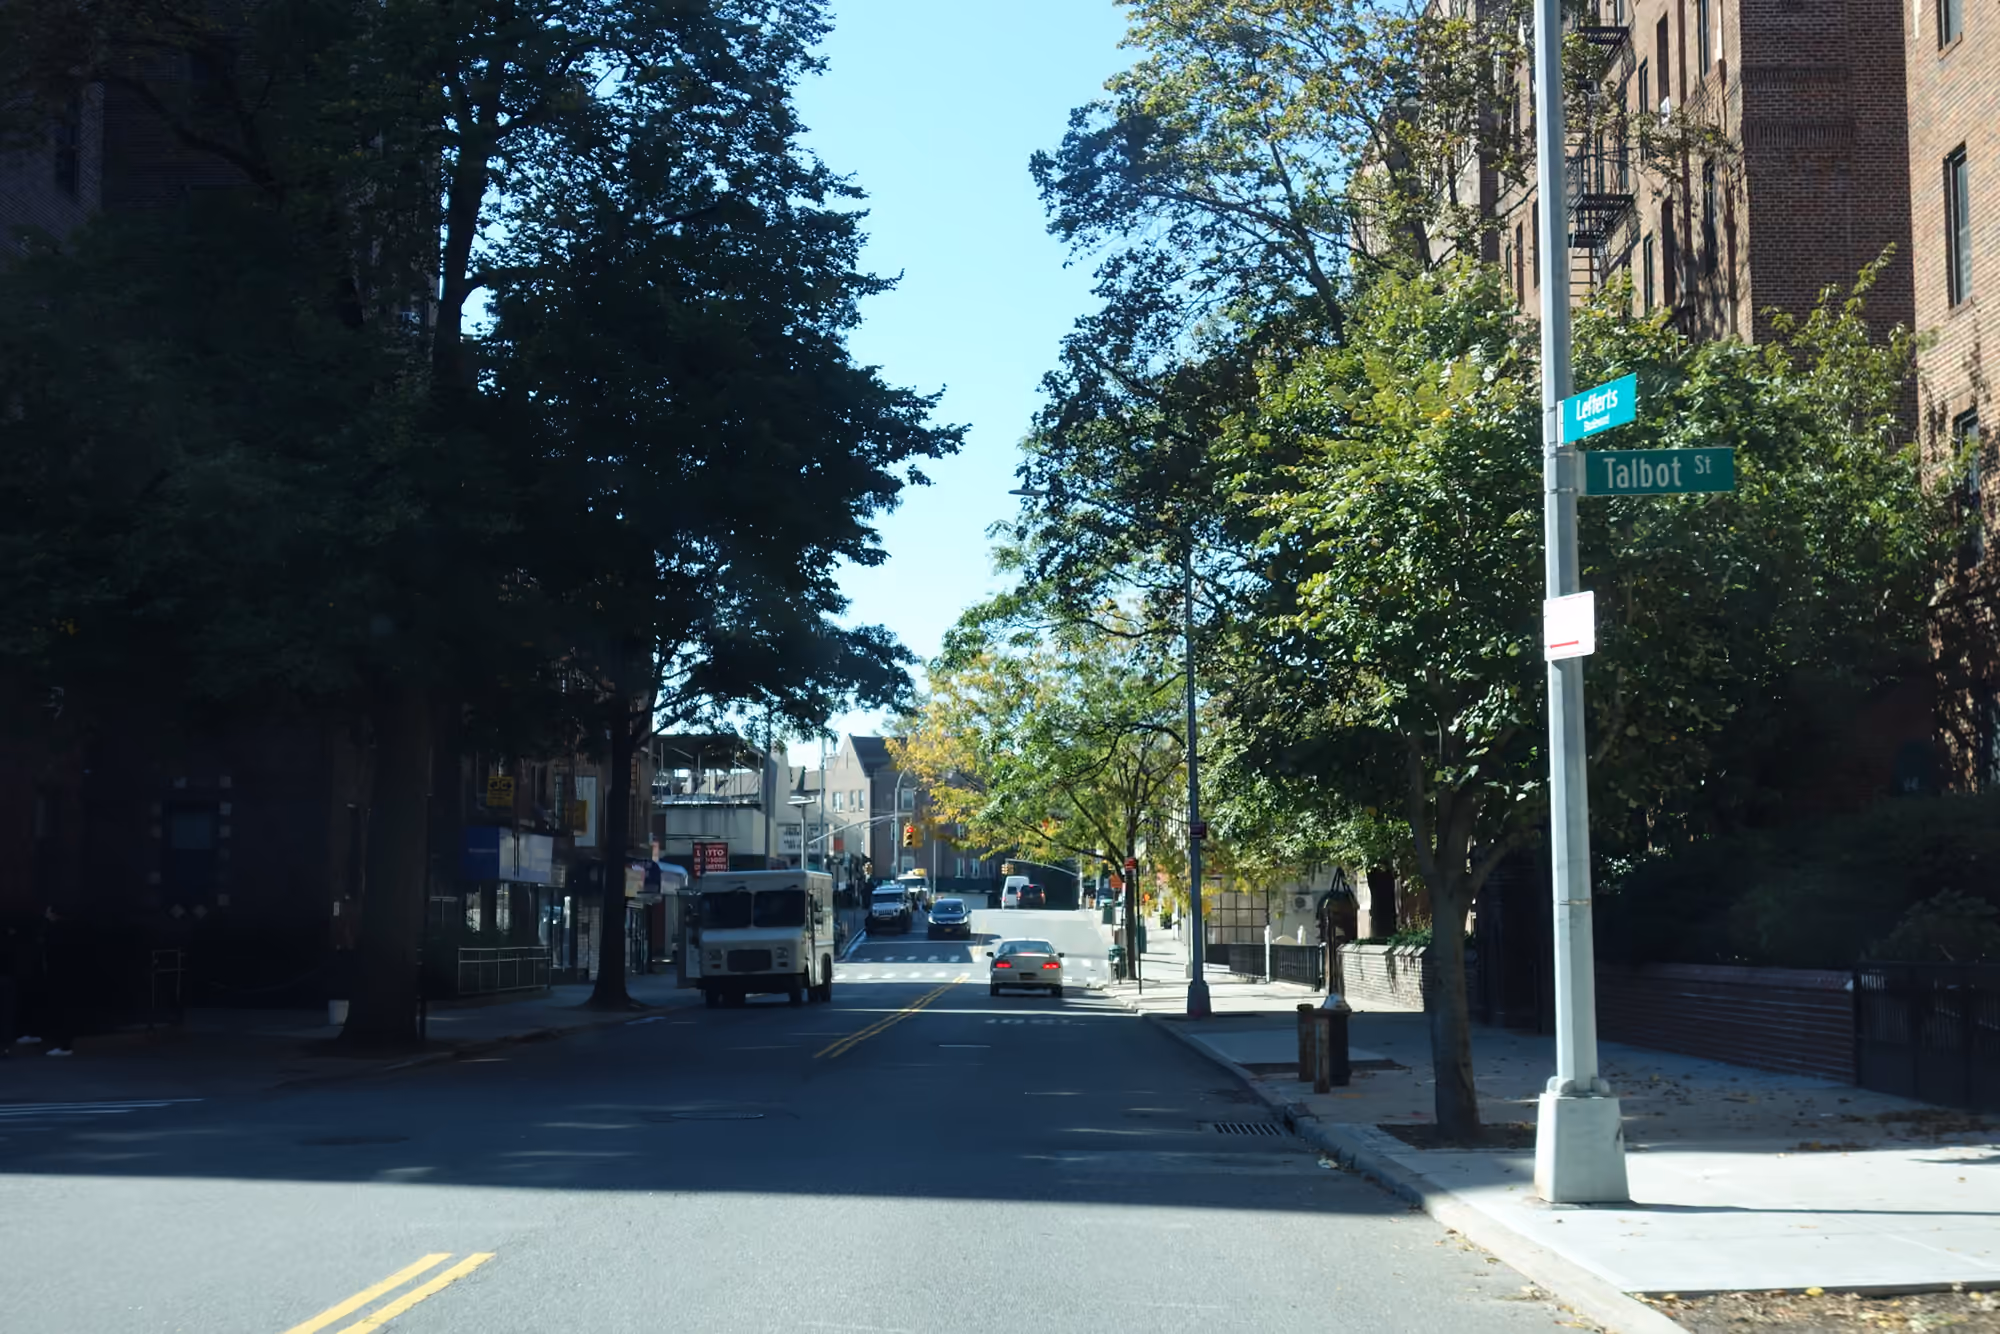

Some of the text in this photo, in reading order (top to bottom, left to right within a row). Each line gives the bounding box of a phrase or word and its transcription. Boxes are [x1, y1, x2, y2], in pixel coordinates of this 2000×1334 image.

[1576, 388, 1618, 421] Lefferts
[1603, 455, 1712, 488] Talbot St
